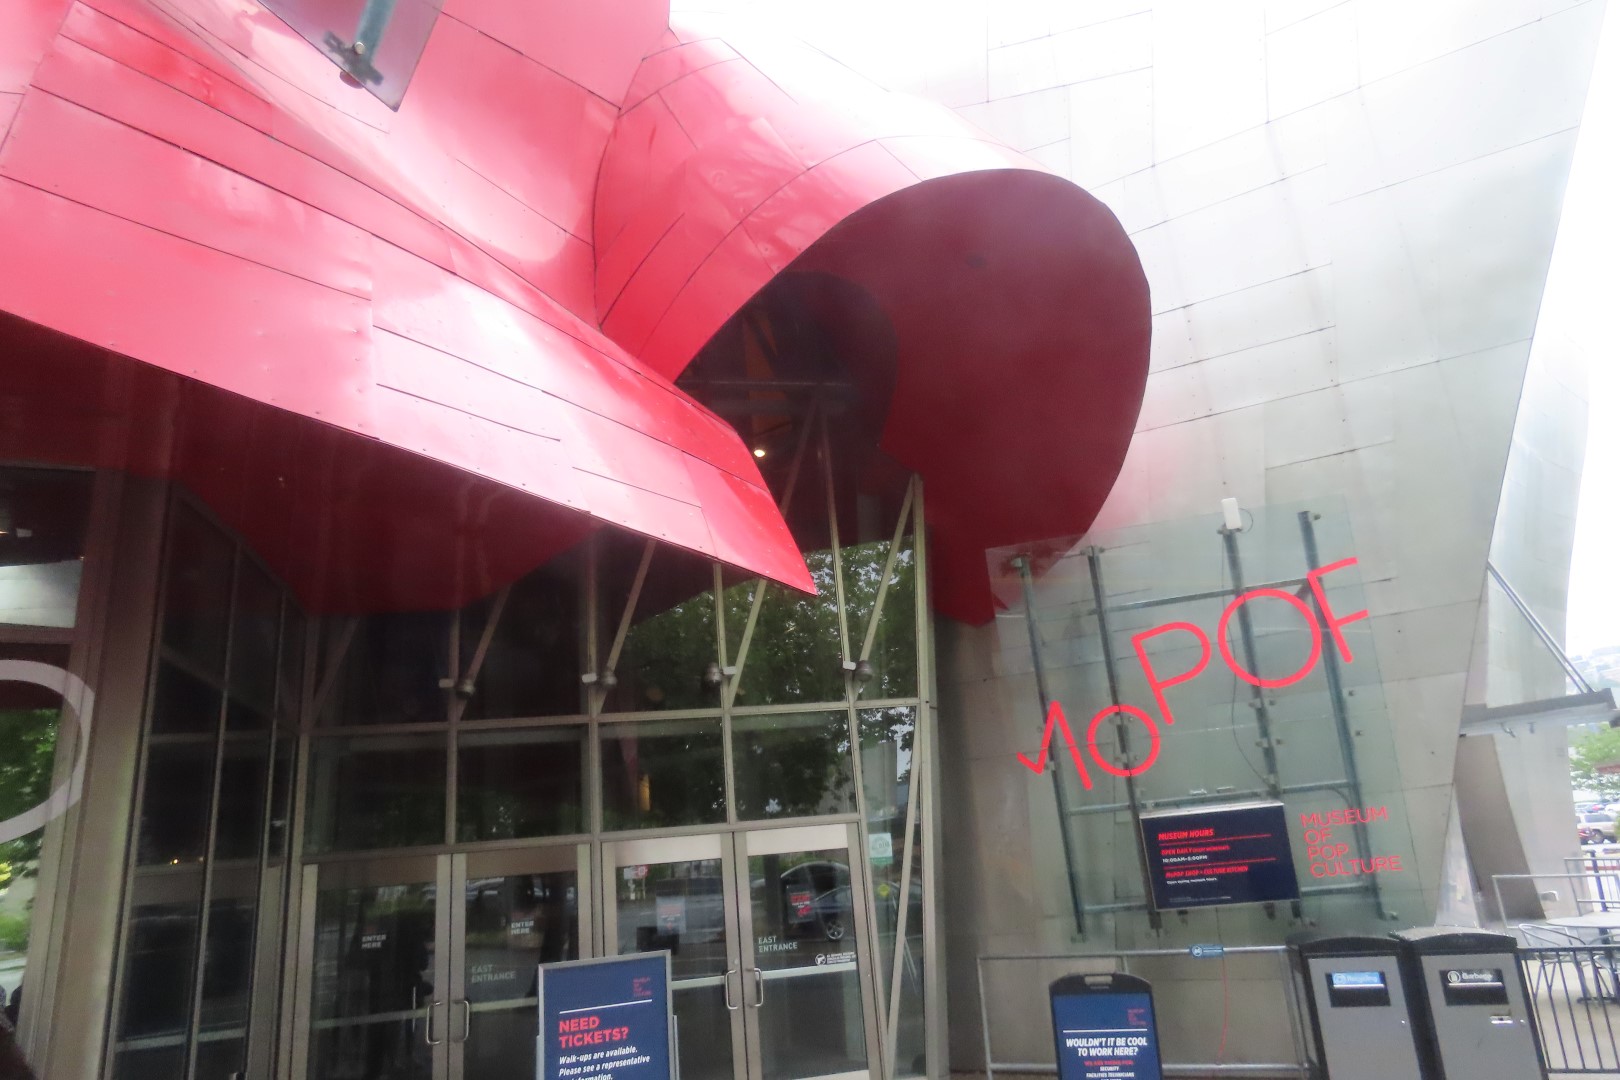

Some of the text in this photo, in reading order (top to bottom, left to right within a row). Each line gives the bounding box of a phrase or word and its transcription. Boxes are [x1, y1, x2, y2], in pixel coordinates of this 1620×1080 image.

[1300, 806, 1389, 828] MUSEUM
[1158, 828, 1215, 841] MUSEUM HOURS
[1304, 828, 1332, 844] OF
[1307, 843, 1349, 861] POP
[1309, 856, 1404, 878] CULTURE
[511, 920, 534, 928] ENTER
[511, 927, 530, 935] HERE
[362, 934, 386, 942] ENTER
[758, 936, 777, 945] EAST
[361, 941, 381, 949] HERE
[758, 942, 798, 952] ENTRANCE
[471, 964, 493, 973] EAST
[471, 971, 516, 983] ENTRANCE
[559, 1016, 600, 1033] NEED
[559, 1026, 629, 1049] TICKETS?
[1066, 1036, 1147, 1047] WOULDN'T IT BE COOL
[559, 1045, 638, 1065] Walk-ups are available.
[1077, 1047, 1139, 1057] TO WORK HERE?
[559, 1055, 651, 1077] Please see a representative
